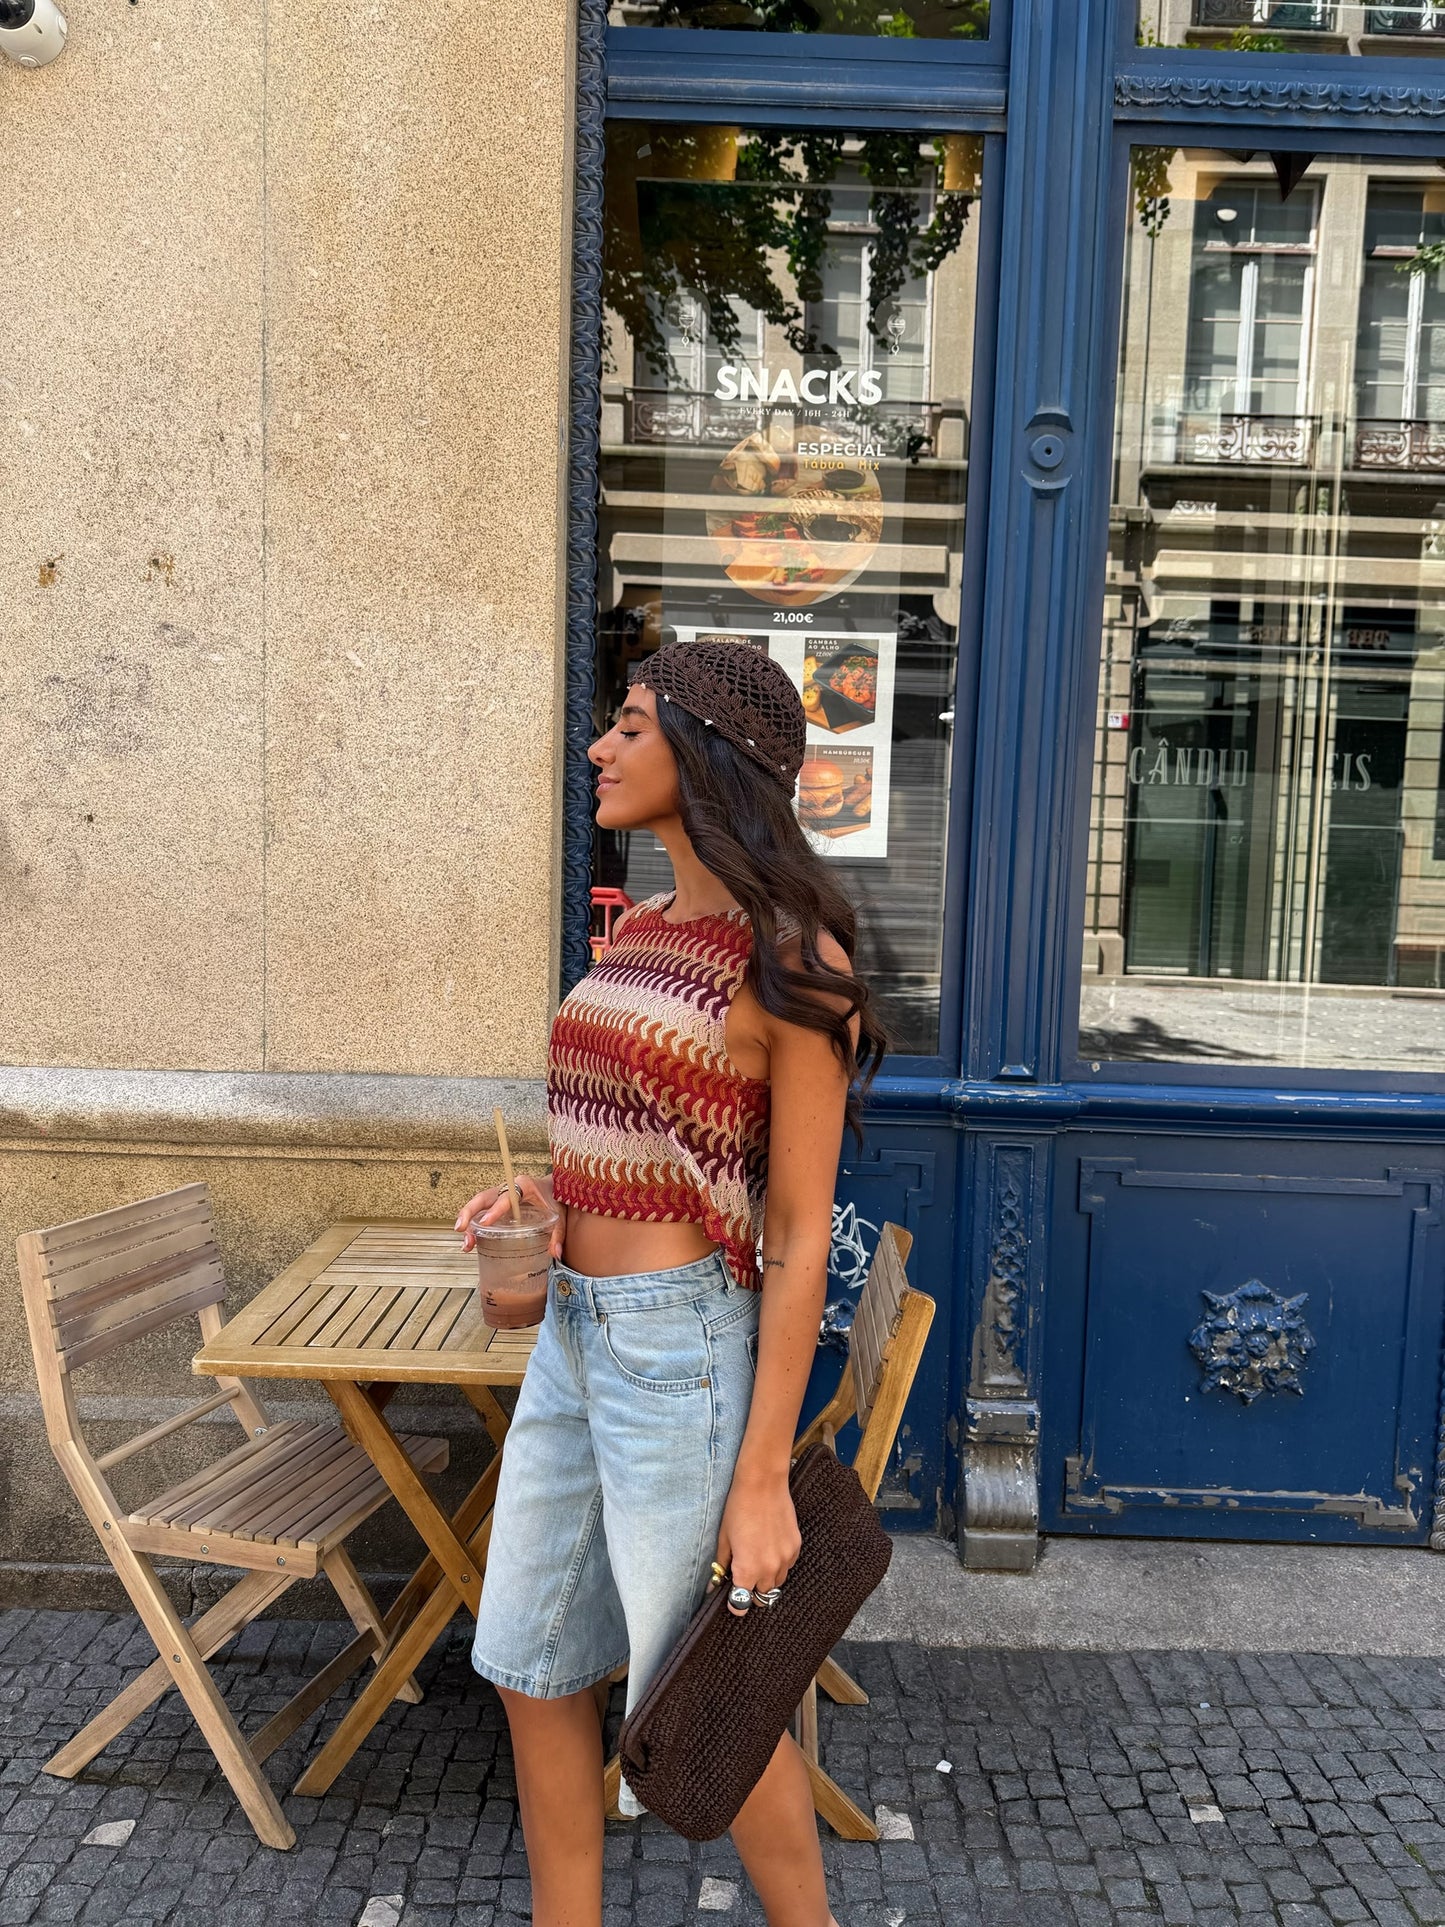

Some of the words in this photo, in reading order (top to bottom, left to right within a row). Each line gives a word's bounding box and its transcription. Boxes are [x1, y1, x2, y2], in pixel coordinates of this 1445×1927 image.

[714, 365, 883, 406] SNACKS
[739, 407, 771, 416] EVERY
[774, 408, 794, 416] DAY
[797, 442, 887, 457] ESPECIAL
[803, 458, 845, 470] Tábua
[858, 459, 880, 471] Mix
[772, 612, 814, 625] 21,00€
[1127, 737, 1250, 788] CÂNDID
